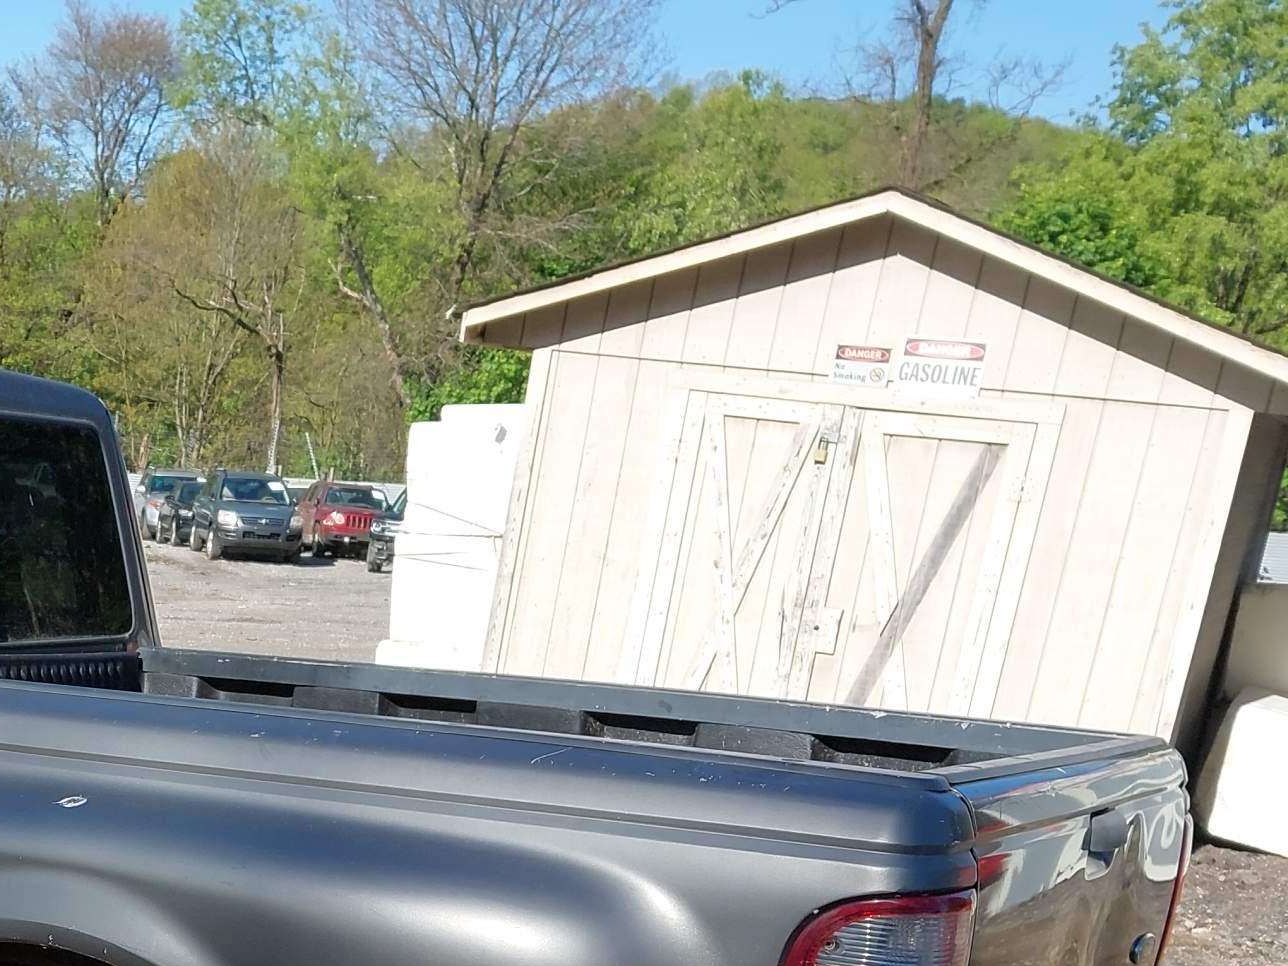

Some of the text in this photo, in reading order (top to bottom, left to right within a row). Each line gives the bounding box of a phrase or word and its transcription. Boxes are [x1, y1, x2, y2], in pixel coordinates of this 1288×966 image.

[844, 348, 882, 361] DANGER
[833, 372, 867, 383] Smoking
[898, 361, 982, 387] GASOLINE
